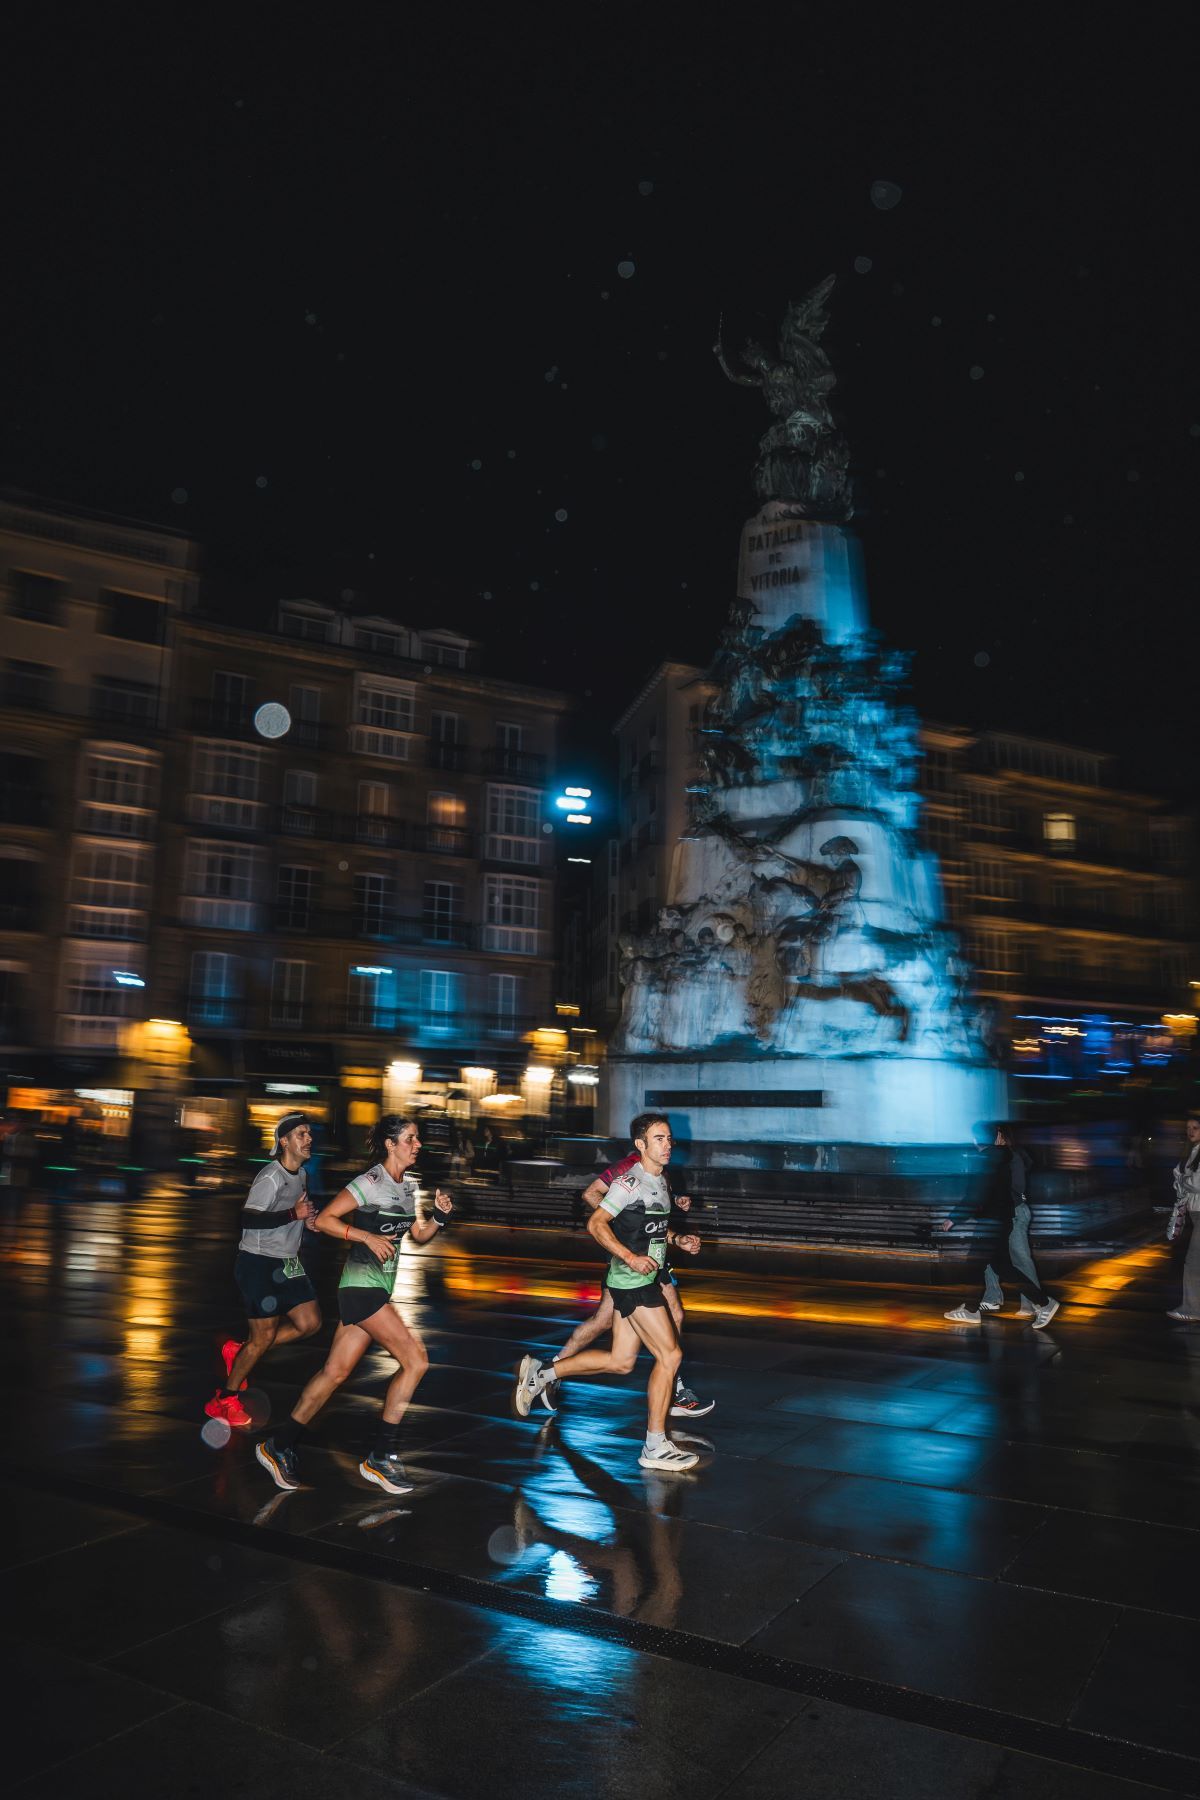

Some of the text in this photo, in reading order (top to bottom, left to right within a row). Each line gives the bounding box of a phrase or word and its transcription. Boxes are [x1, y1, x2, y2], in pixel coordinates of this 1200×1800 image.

[748, 524, 802, 552] BATALLA
[768, 552, 783, 565] DE
[750, 566, 802, 593] VITORIA
